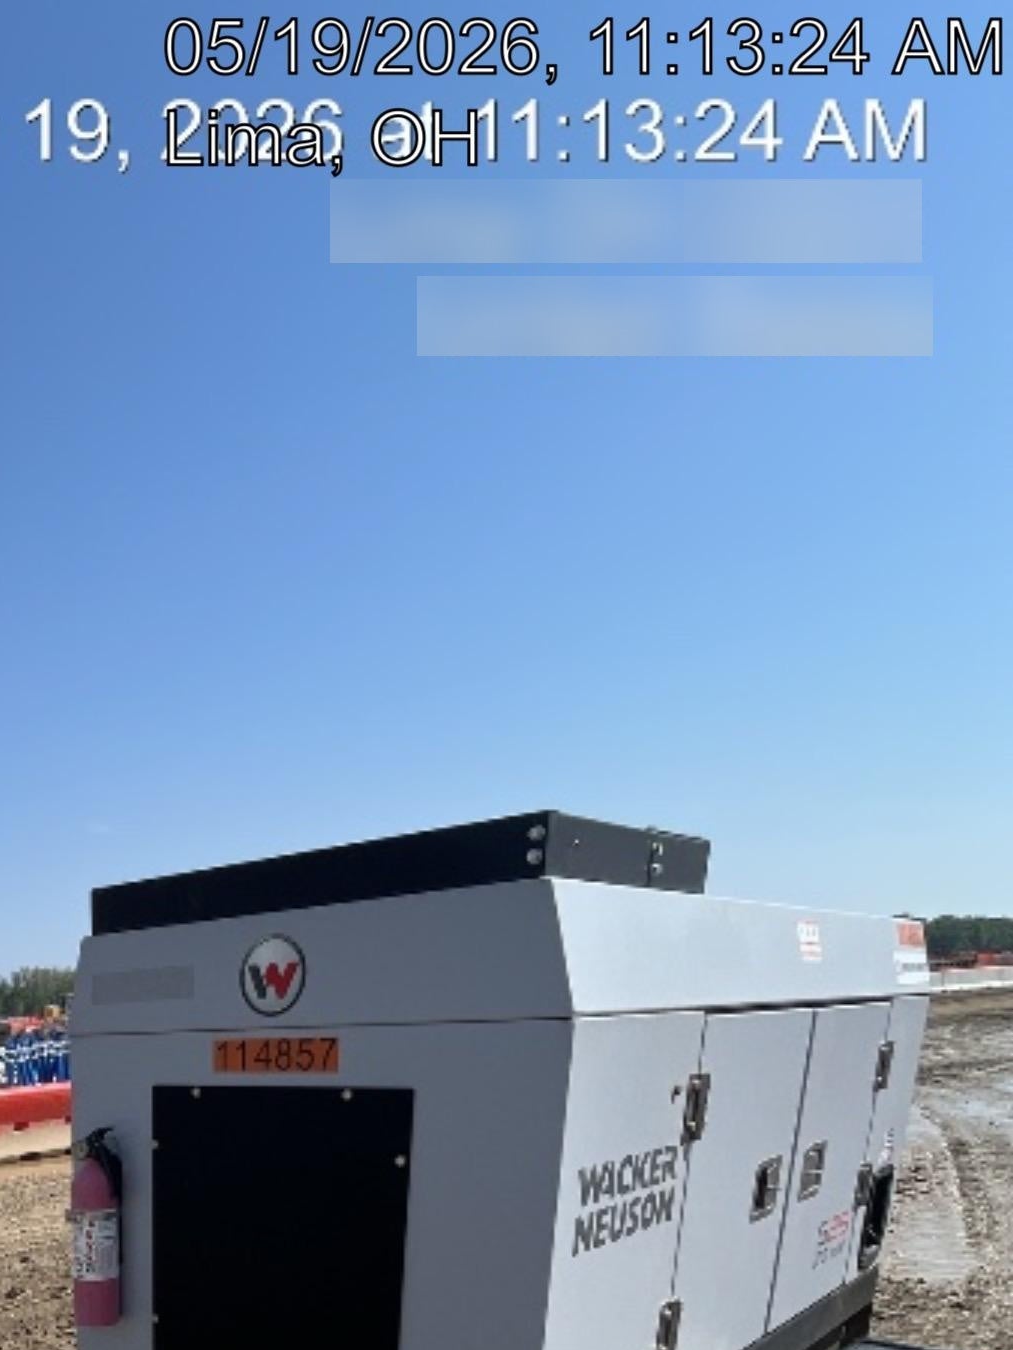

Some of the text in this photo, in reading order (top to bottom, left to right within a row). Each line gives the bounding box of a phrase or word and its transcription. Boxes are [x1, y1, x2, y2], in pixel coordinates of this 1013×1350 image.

[216, 1037, 337, 1072] 114857
[578, 1145, 677, 1206] WACKER
[572, 1186, 675, 1258] NEUSON
